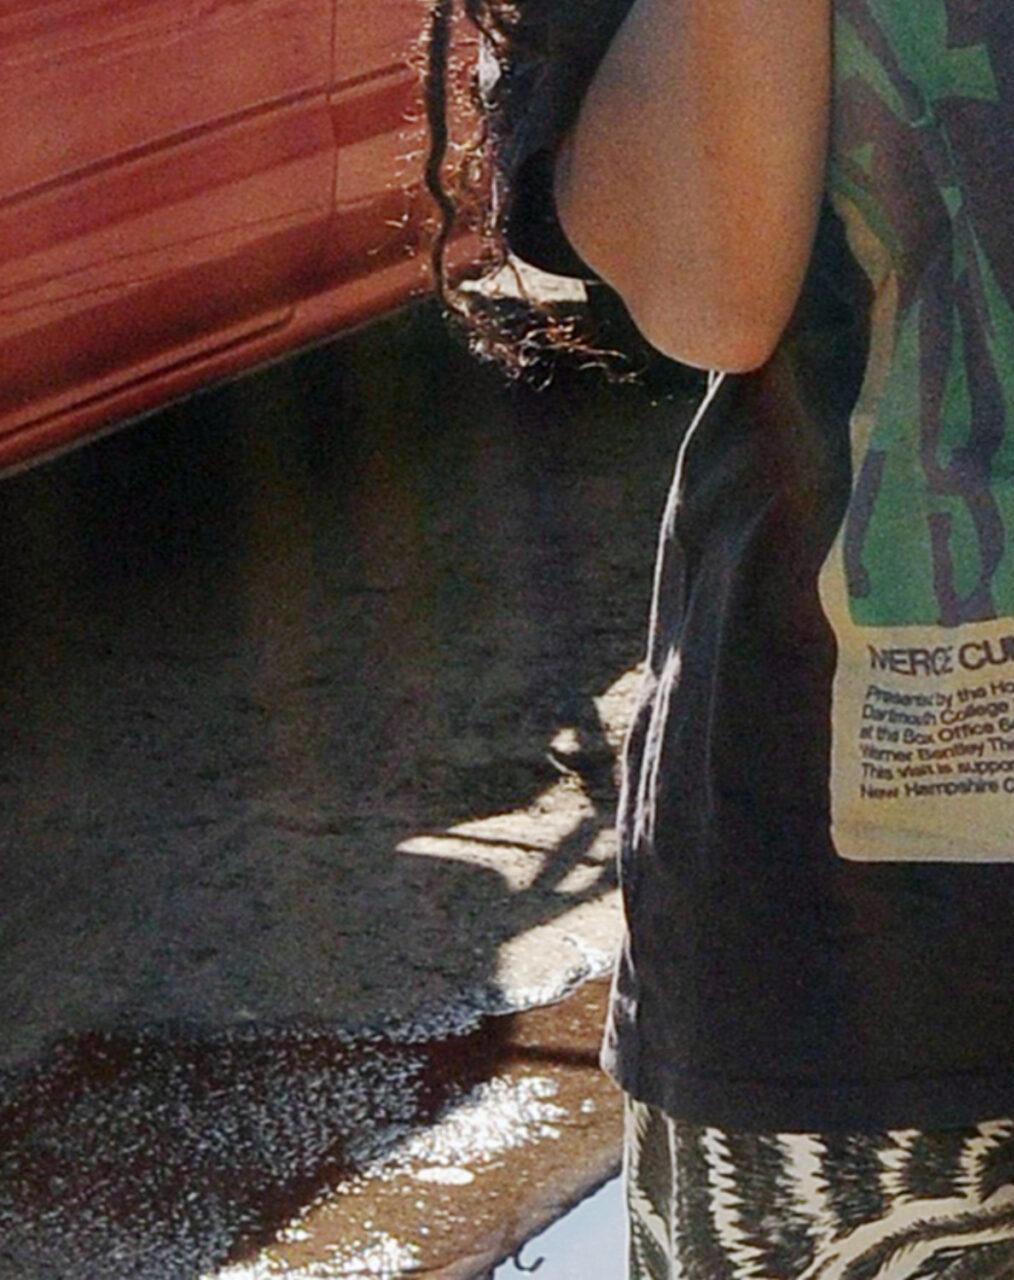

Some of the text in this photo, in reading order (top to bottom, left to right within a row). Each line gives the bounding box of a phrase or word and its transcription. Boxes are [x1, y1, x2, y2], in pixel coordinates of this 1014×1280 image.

[867, 643, 954, 677] MERCE
[935, 691, 953, 708] by
[957, 685, 987, 702] the
[862, 703, 937, 726] Dartmouth
[939, 700, 1009, 725] College
[876, 725, 900, 743] the
[903, 727, 936, 745] Box
[938, 722, 995, 743] Office
[862, 761, 894, 781] This
[904, 776, 999, 798] Hampshire
